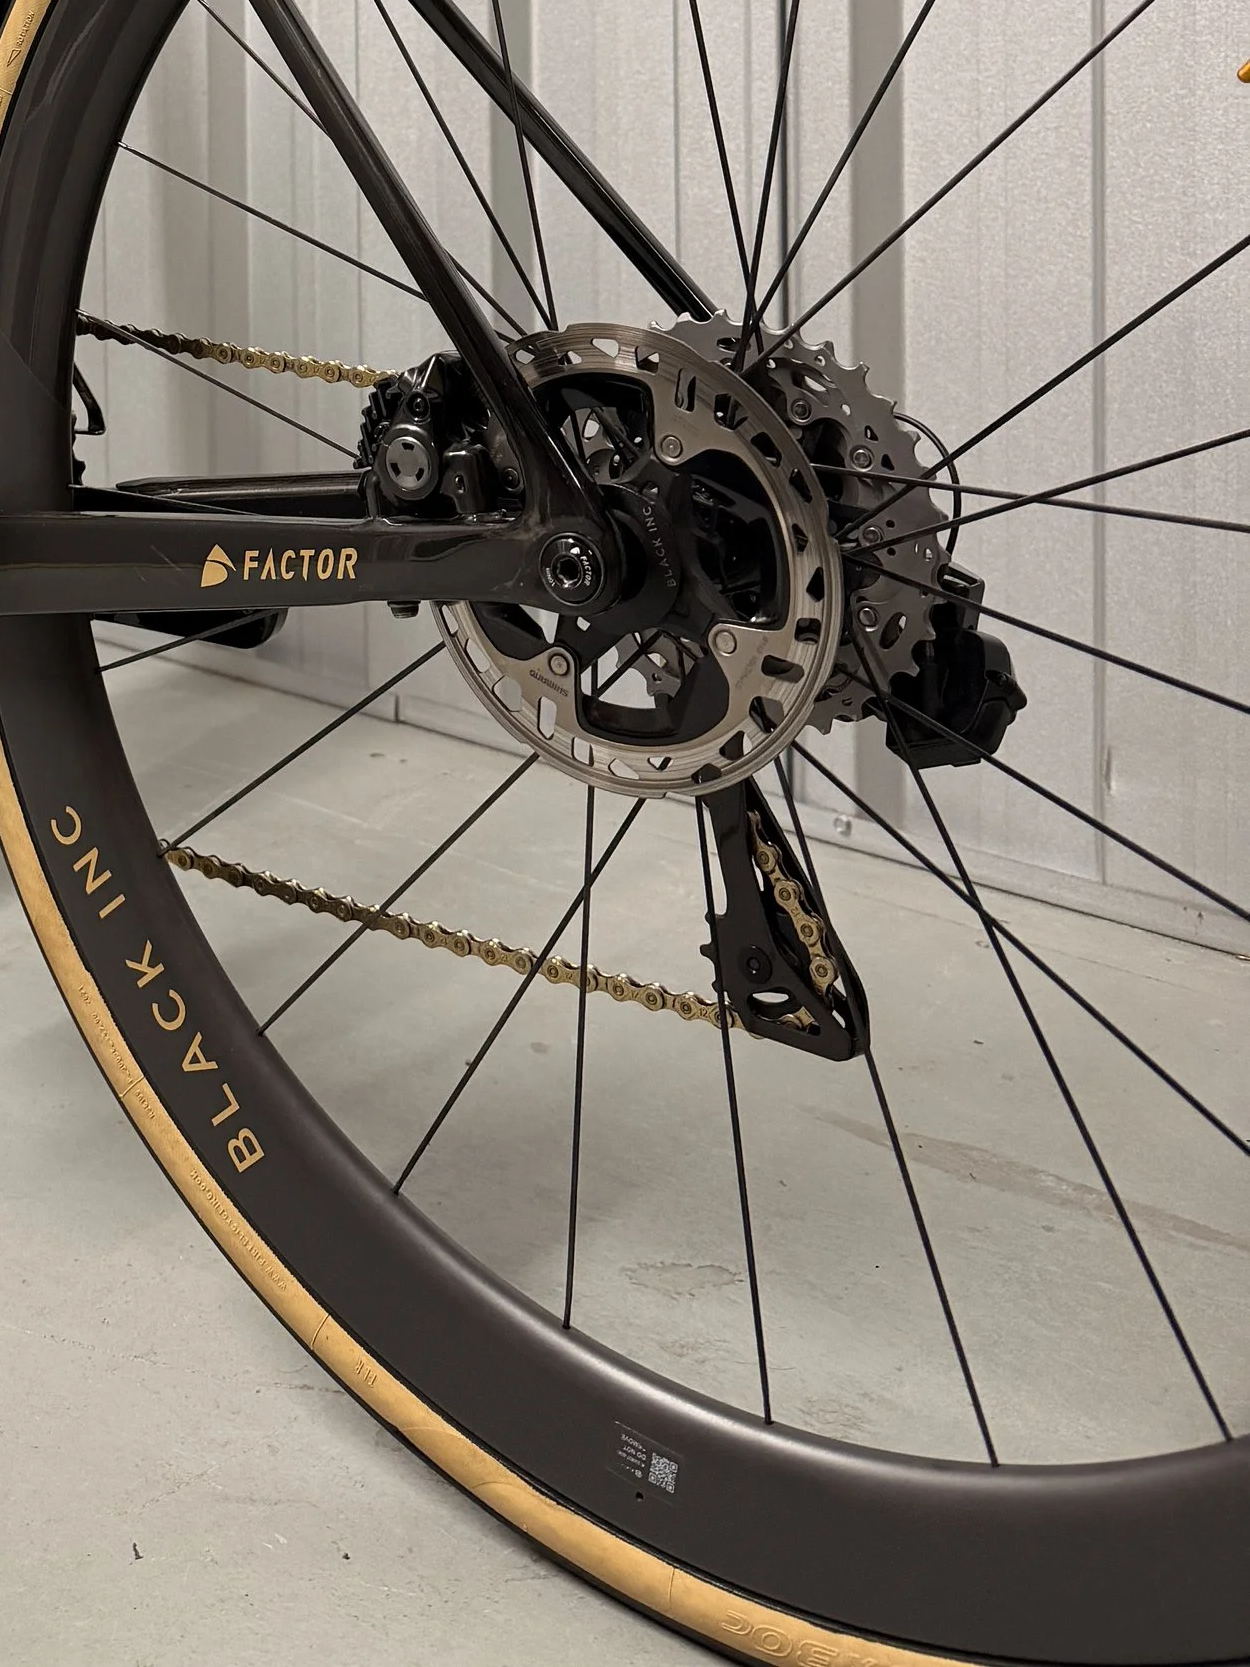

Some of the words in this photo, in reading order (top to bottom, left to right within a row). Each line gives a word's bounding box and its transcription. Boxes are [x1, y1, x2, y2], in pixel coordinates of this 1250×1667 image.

[641, 504, 663, 538] INC
[243, 547, 358, 581] FACTOR
[579, 555, 593, 588] FACTOR
[651, 537, 678, 590] BLACK
[50, 805, 126, 919] INC
[124, 939, 266, 1174] BLACK
